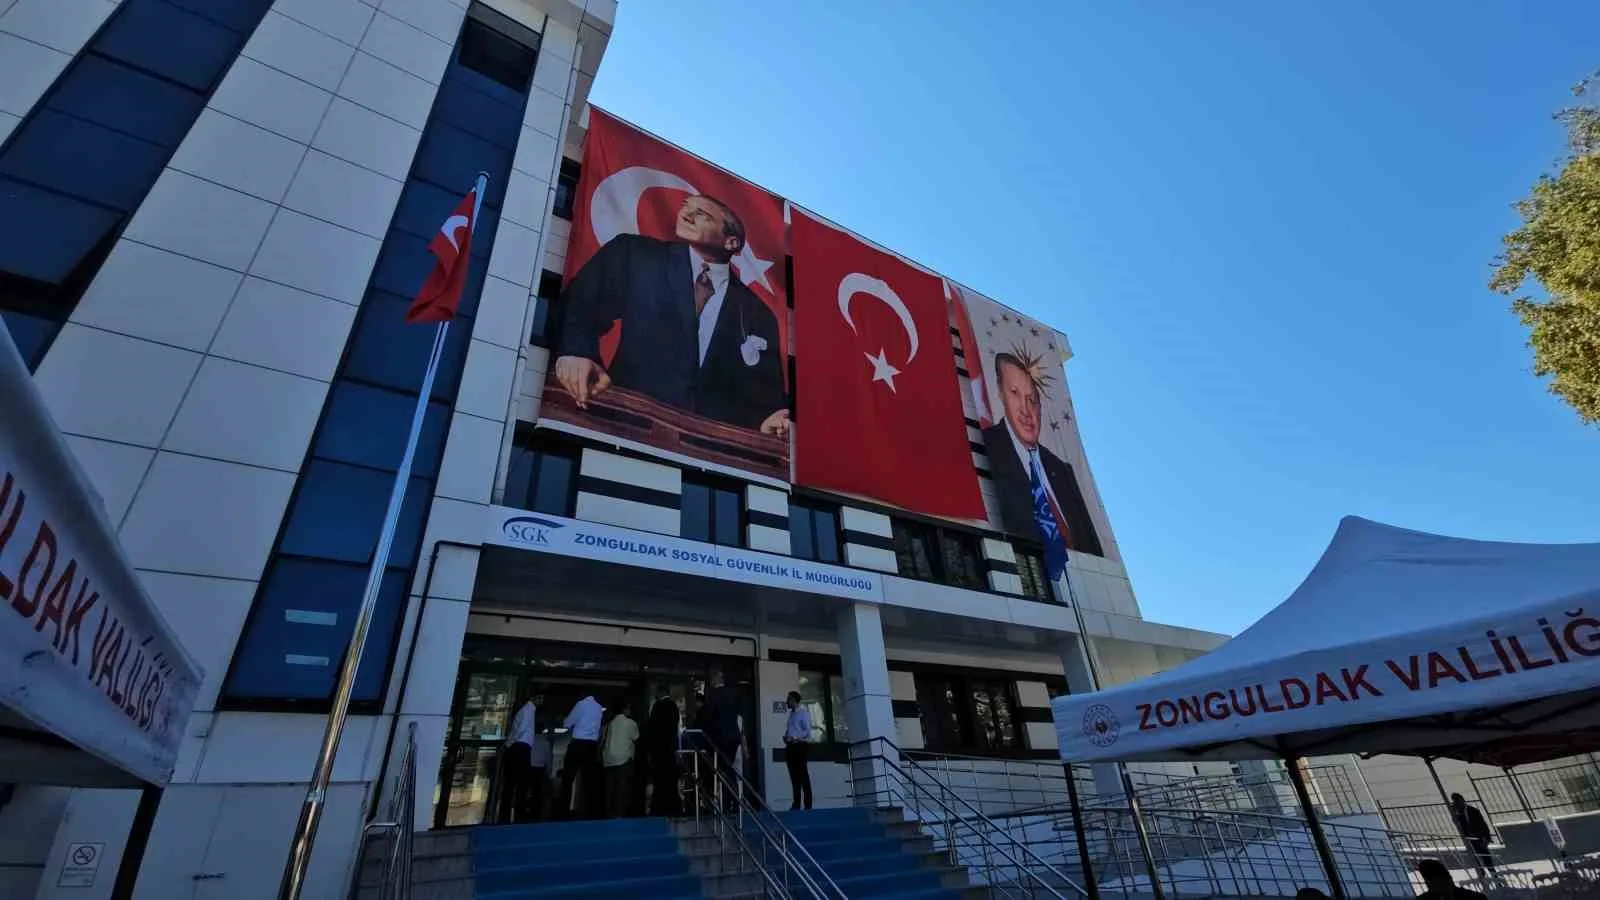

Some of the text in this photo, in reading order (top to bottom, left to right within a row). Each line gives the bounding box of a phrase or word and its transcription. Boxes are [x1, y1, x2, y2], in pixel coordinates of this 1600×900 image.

[509, 525, 550, 544] SGK
[574, 533, 668, 558] ZONGULDAK
[672, 549, 723, 566] SOSYAL
[726, 558, 789, 577] GÜVENLİK
[792, 567, 804, 580] İL
[1135, 664, 1384, 731] ZONGULDAK
